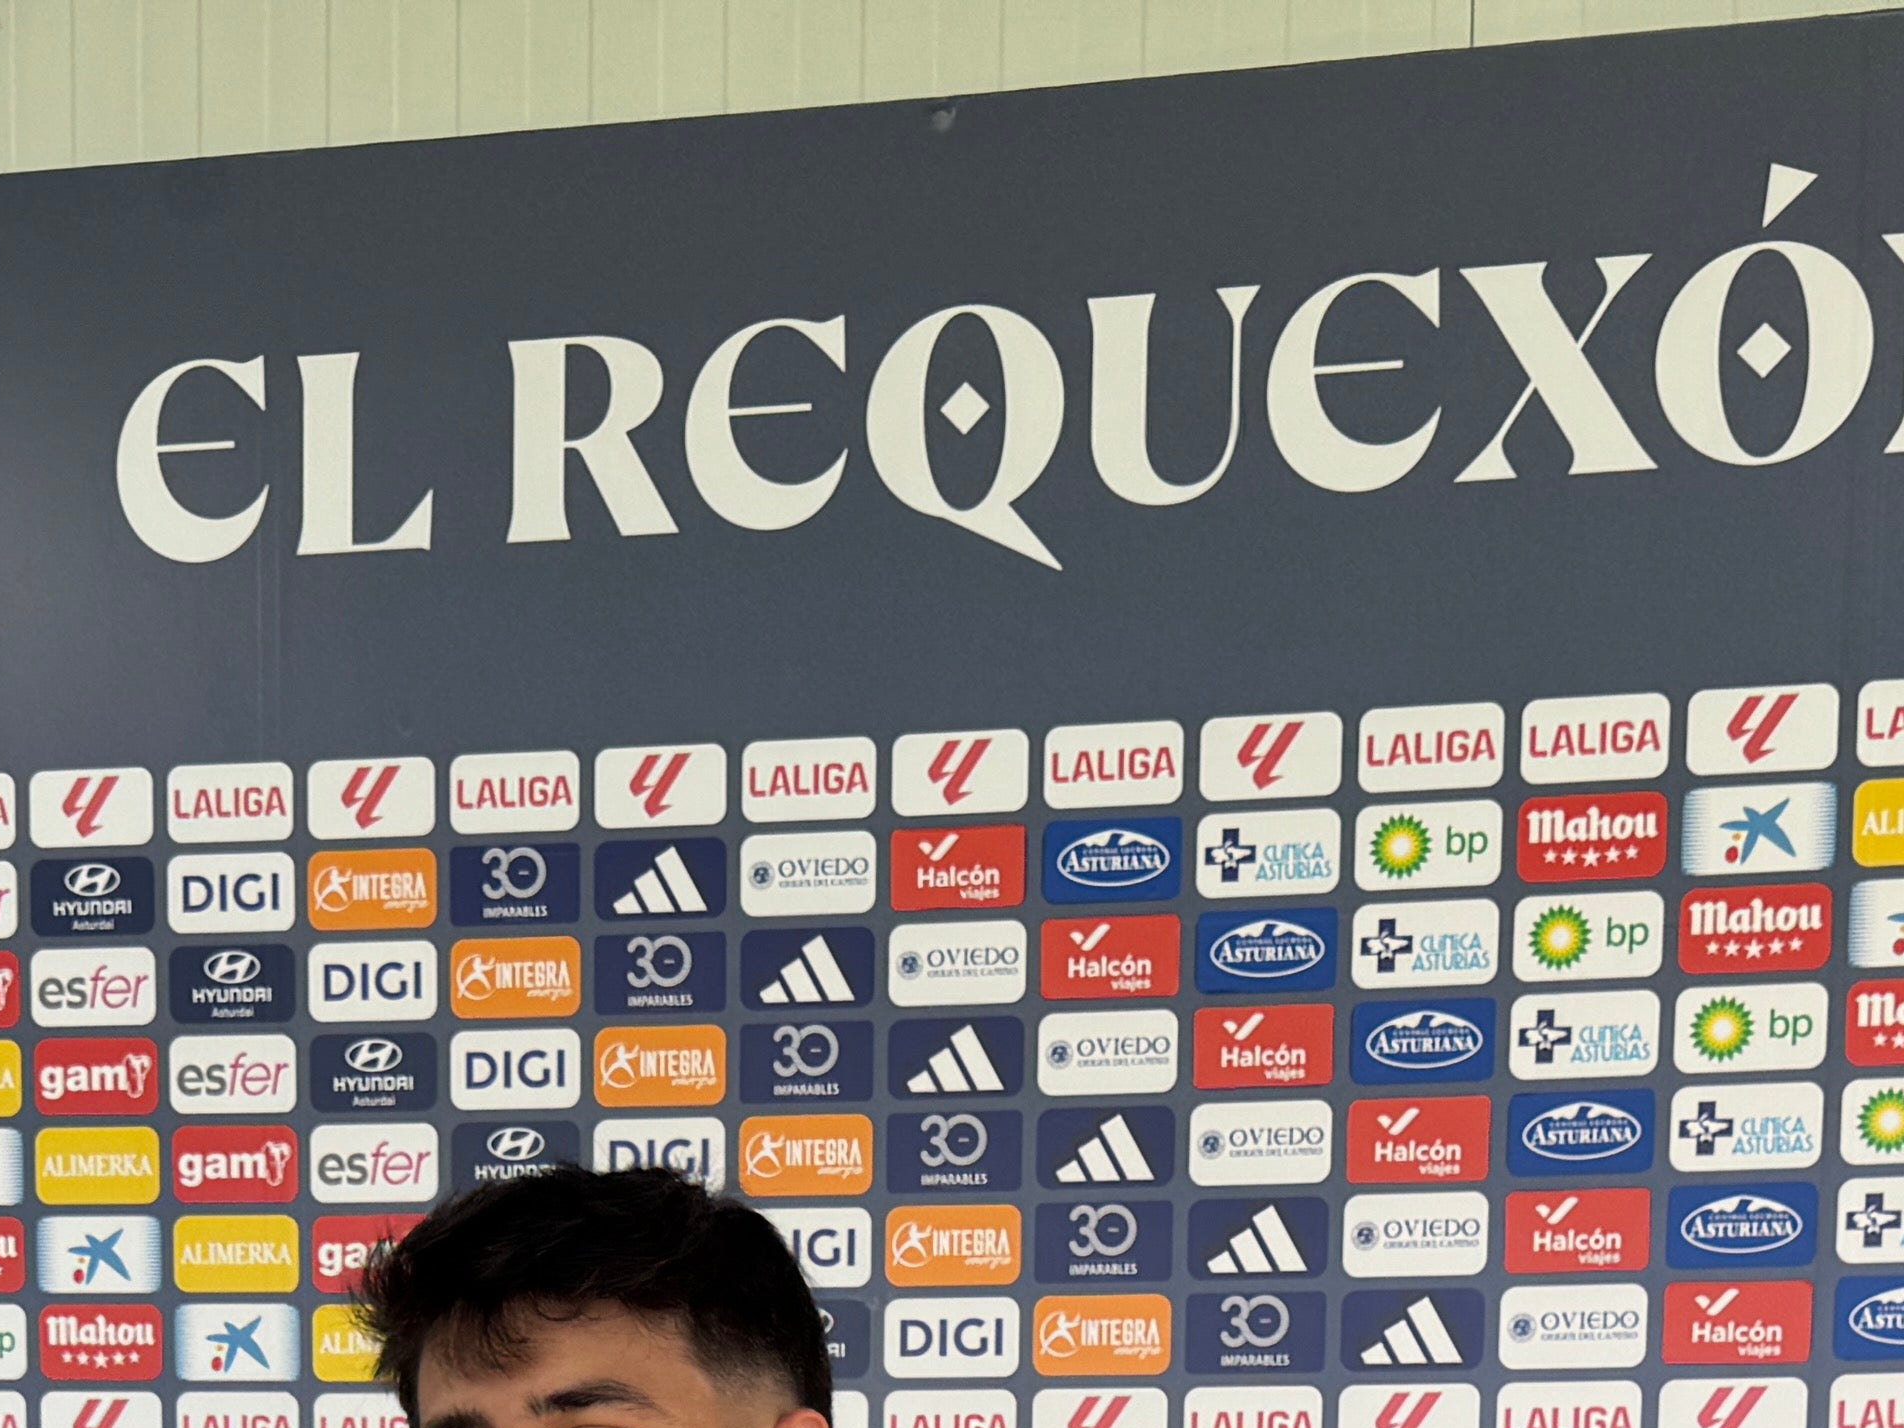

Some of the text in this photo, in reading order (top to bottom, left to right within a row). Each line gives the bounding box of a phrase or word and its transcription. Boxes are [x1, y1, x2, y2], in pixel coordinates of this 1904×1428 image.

[117, 352, 433, 562] EL
[173, 785, 287, 820] LALIGA
[456, 774, 573, 810] LALIGA
[1446, 824, 1489, 862] bp
[465, 1049, 565, 1089] DIGI
[785, 1138, 863, 1167] INTEGRA
[1375, 1138, 1461, 1162] Halcón
